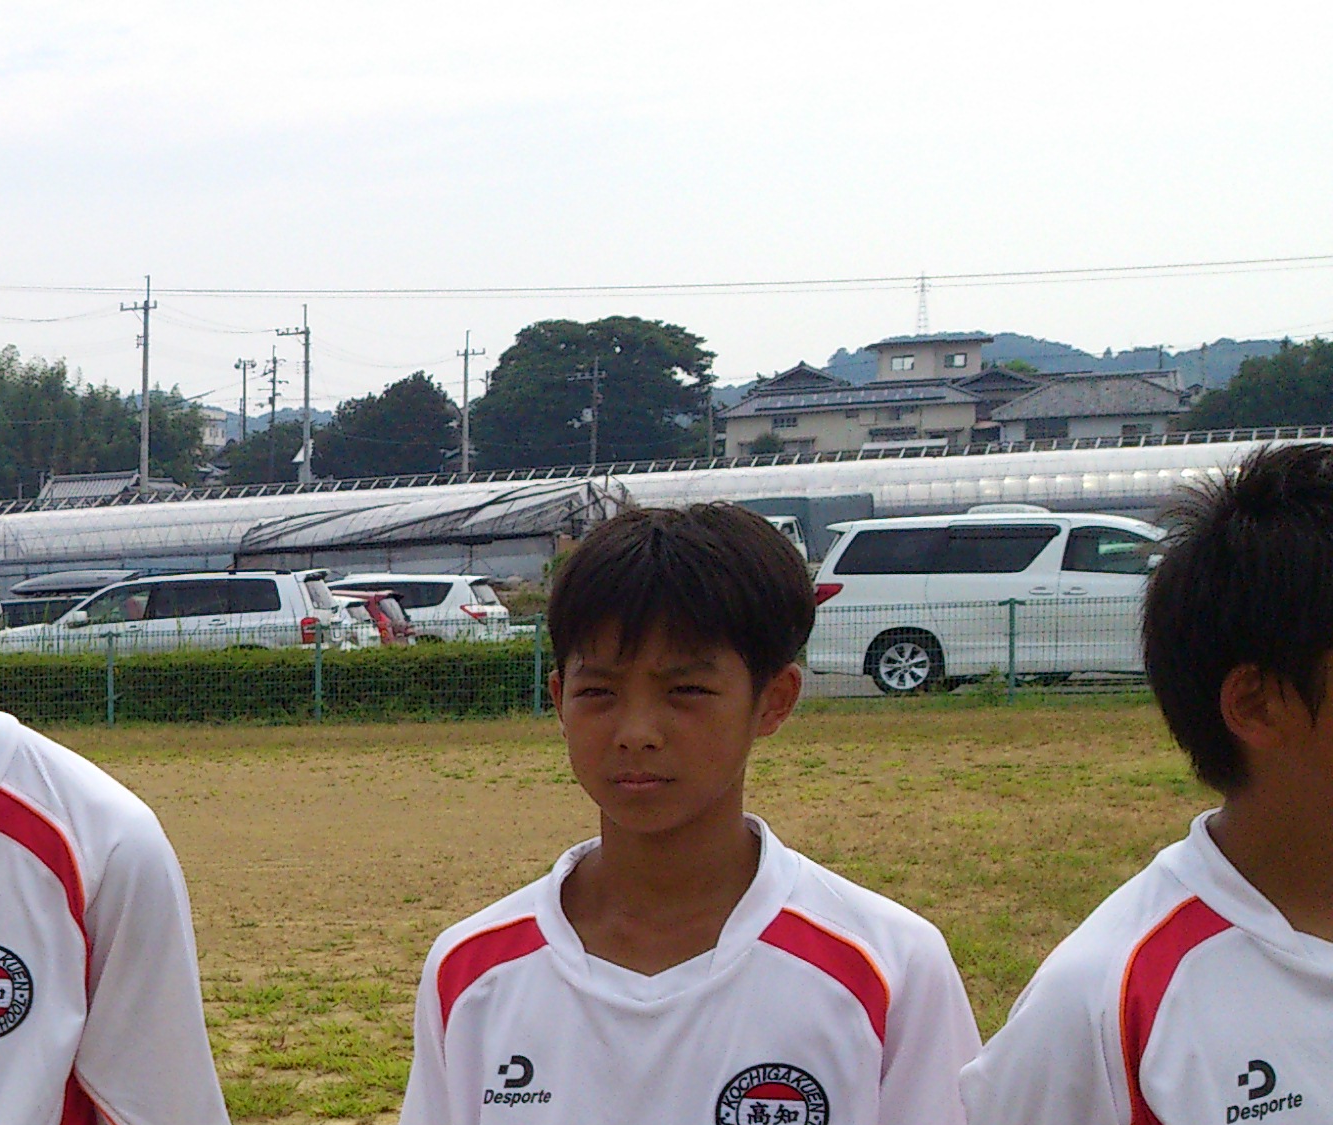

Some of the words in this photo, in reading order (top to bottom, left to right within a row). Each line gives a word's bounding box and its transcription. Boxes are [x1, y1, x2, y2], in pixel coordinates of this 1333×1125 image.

[483, 1089, 552, 1108] Desporte
[722, 1068, 826, 1114] KOCHIGAKUEN
[1226, 1092, 1304, 1125] Desporte
